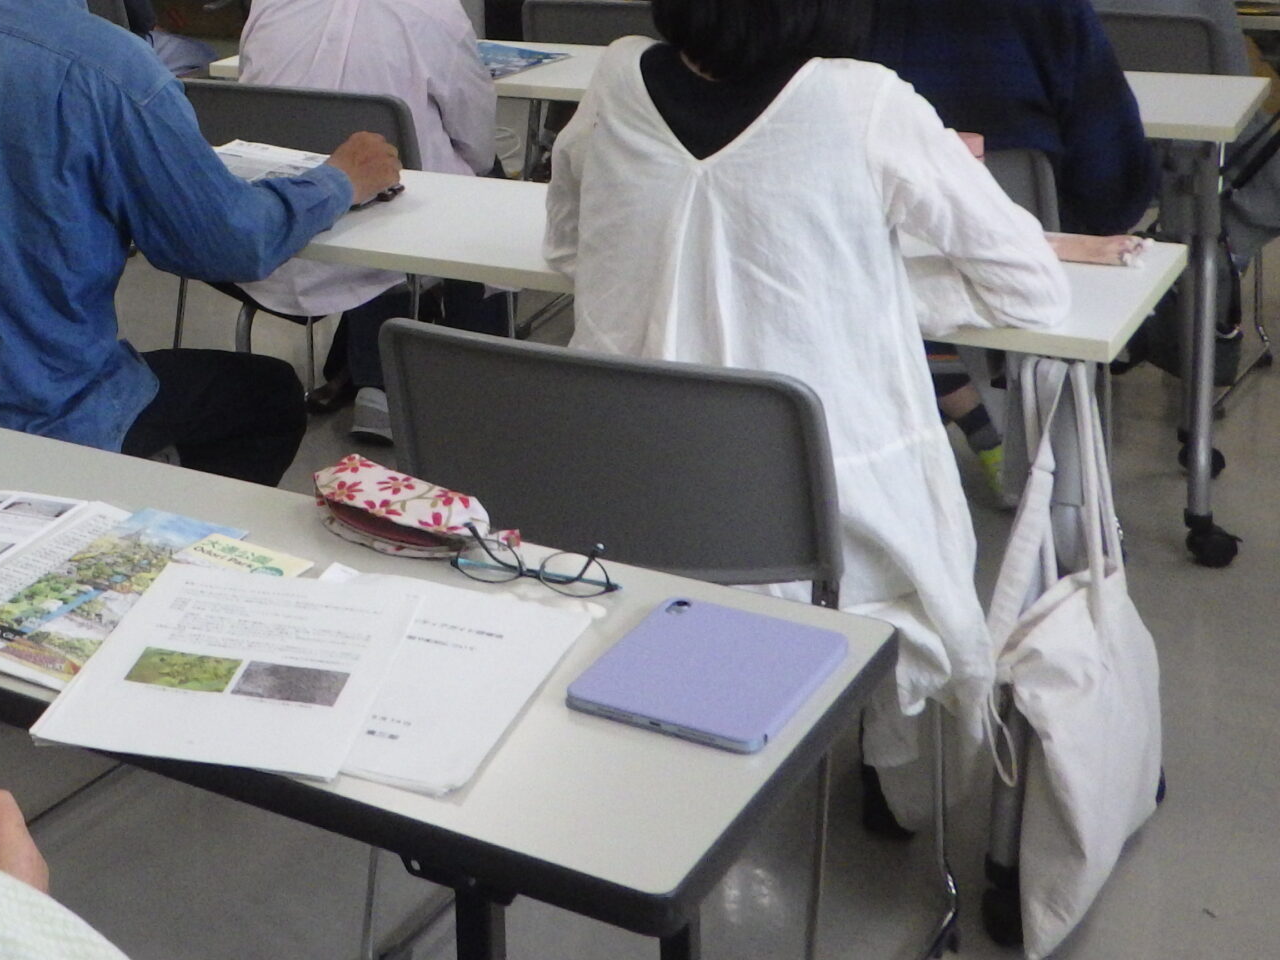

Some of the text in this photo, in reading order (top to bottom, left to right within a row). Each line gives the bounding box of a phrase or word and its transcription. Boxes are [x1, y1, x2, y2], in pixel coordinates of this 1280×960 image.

[193, 545, 253, 569] Odori Park
[200, 540, 274, 565] 大通公園
